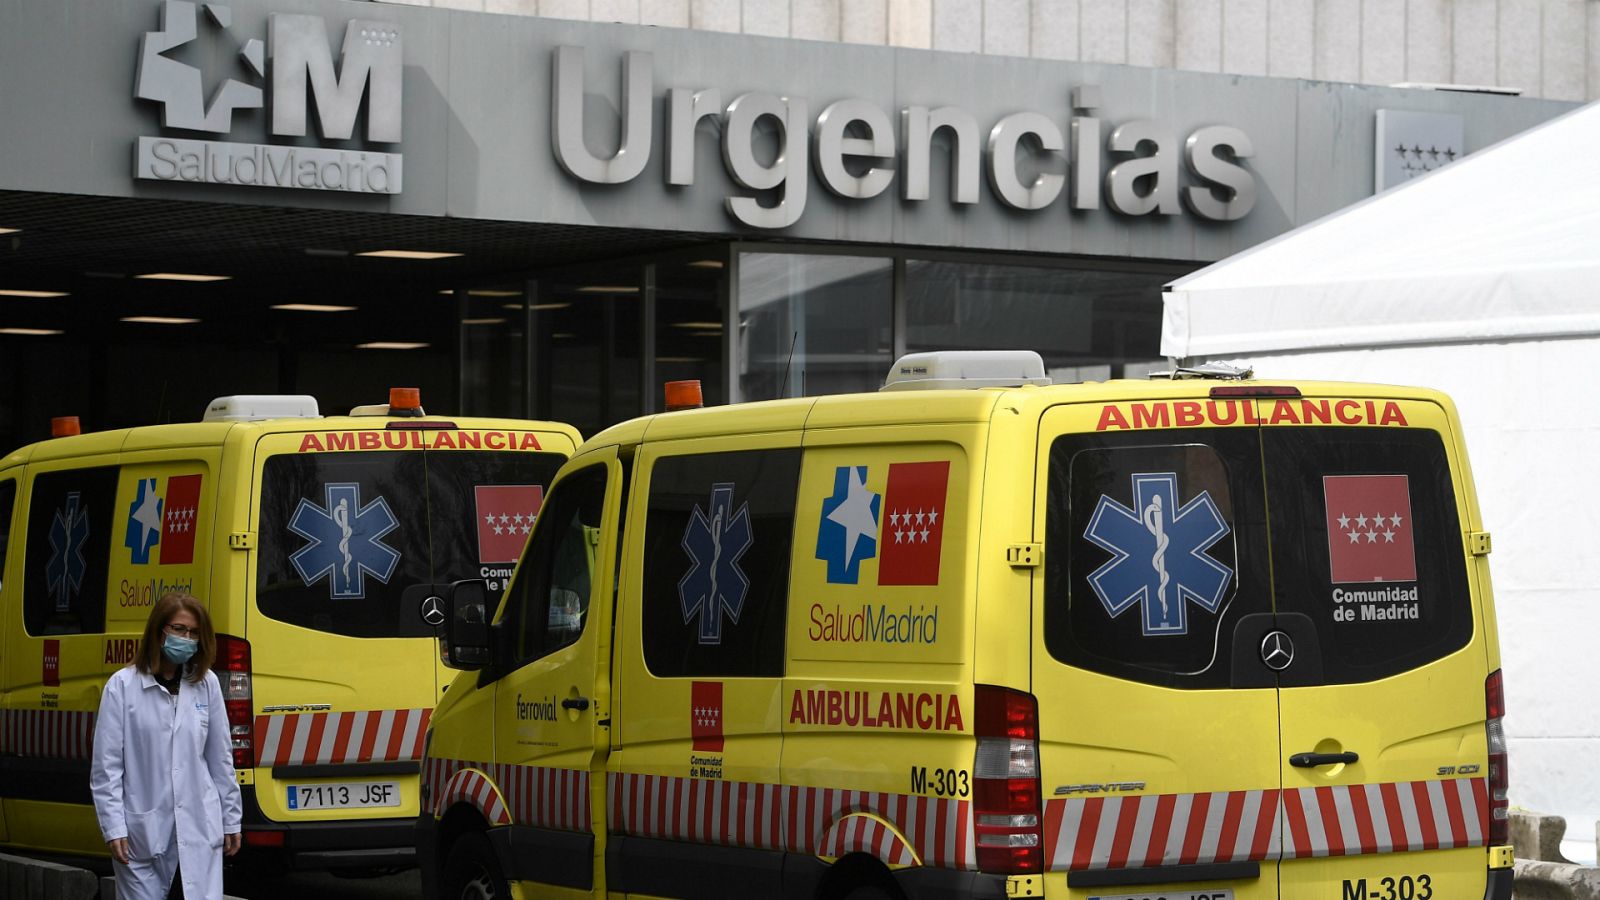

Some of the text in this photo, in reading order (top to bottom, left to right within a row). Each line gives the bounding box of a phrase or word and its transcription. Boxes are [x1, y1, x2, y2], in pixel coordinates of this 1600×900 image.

[553, 46, 1254, 228] Urgencias
[151, 141, 391, 193] SaludMadrid
[1096, 398, 1409, 432] AMBULANCIA
[299, 431, 542, 452] AMBULANCIA
[1332, 586, 1418, 604] Comunidad
[809, 604, 937, 643] SaludMadrid
[1333, 603, 1419, 622] de Madrid
[516, 693, 558, 721] ferrovial
[790, 690, 964, 730] AMBULANCIA
[690, 755, 723, 766] Comunidad
[690, 767, 722, 778] de Madrid
[911, 766, 969, 797] M-303
[1053, 781, 1146, 796] SPRINTER
[301, 784, 393, 807] 7113 JSF
[1342, 874, 1433, 900] M-303
